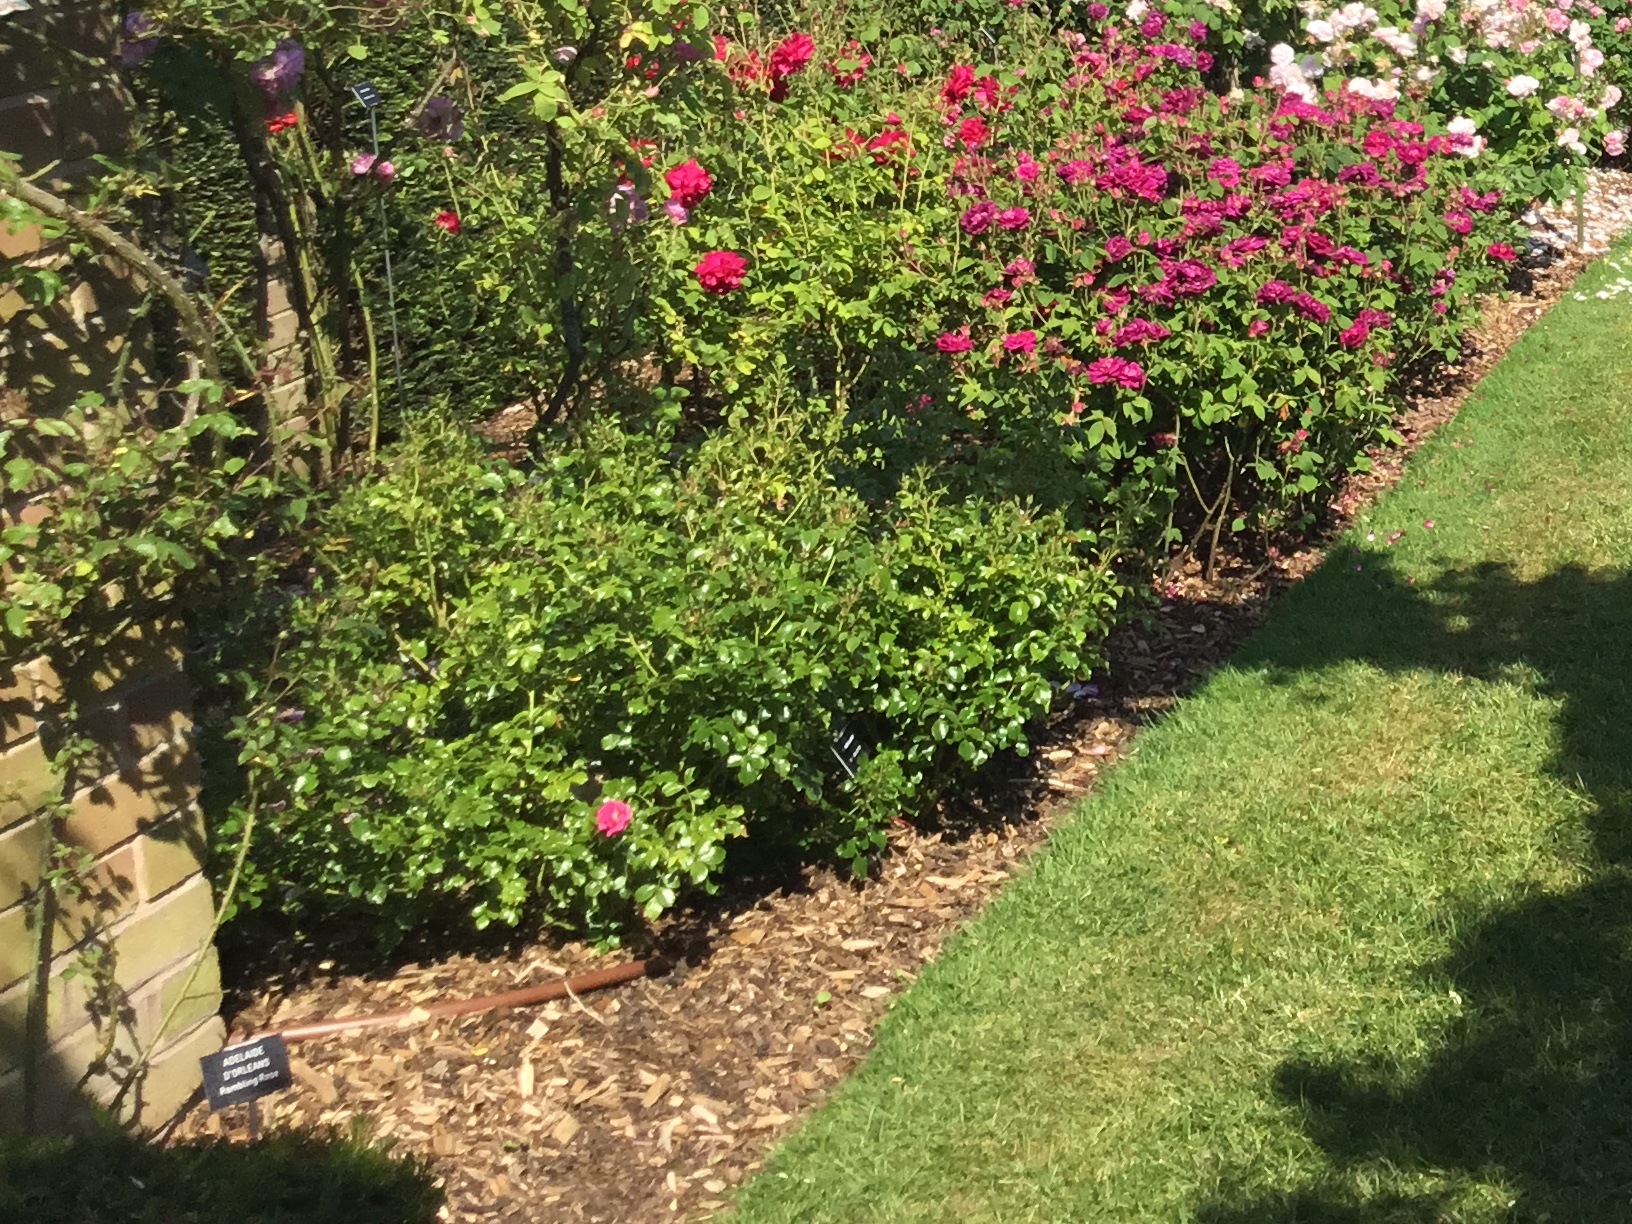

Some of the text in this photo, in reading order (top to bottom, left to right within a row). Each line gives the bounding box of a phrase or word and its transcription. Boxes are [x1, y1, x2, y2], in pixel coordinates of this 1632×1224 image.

[222, 1045, 265, 1067] ADELAIDE
[222, 1057, 271, 1081] D'ORLEANS
[219, 1070, 279, 1096] Rambling Rose
